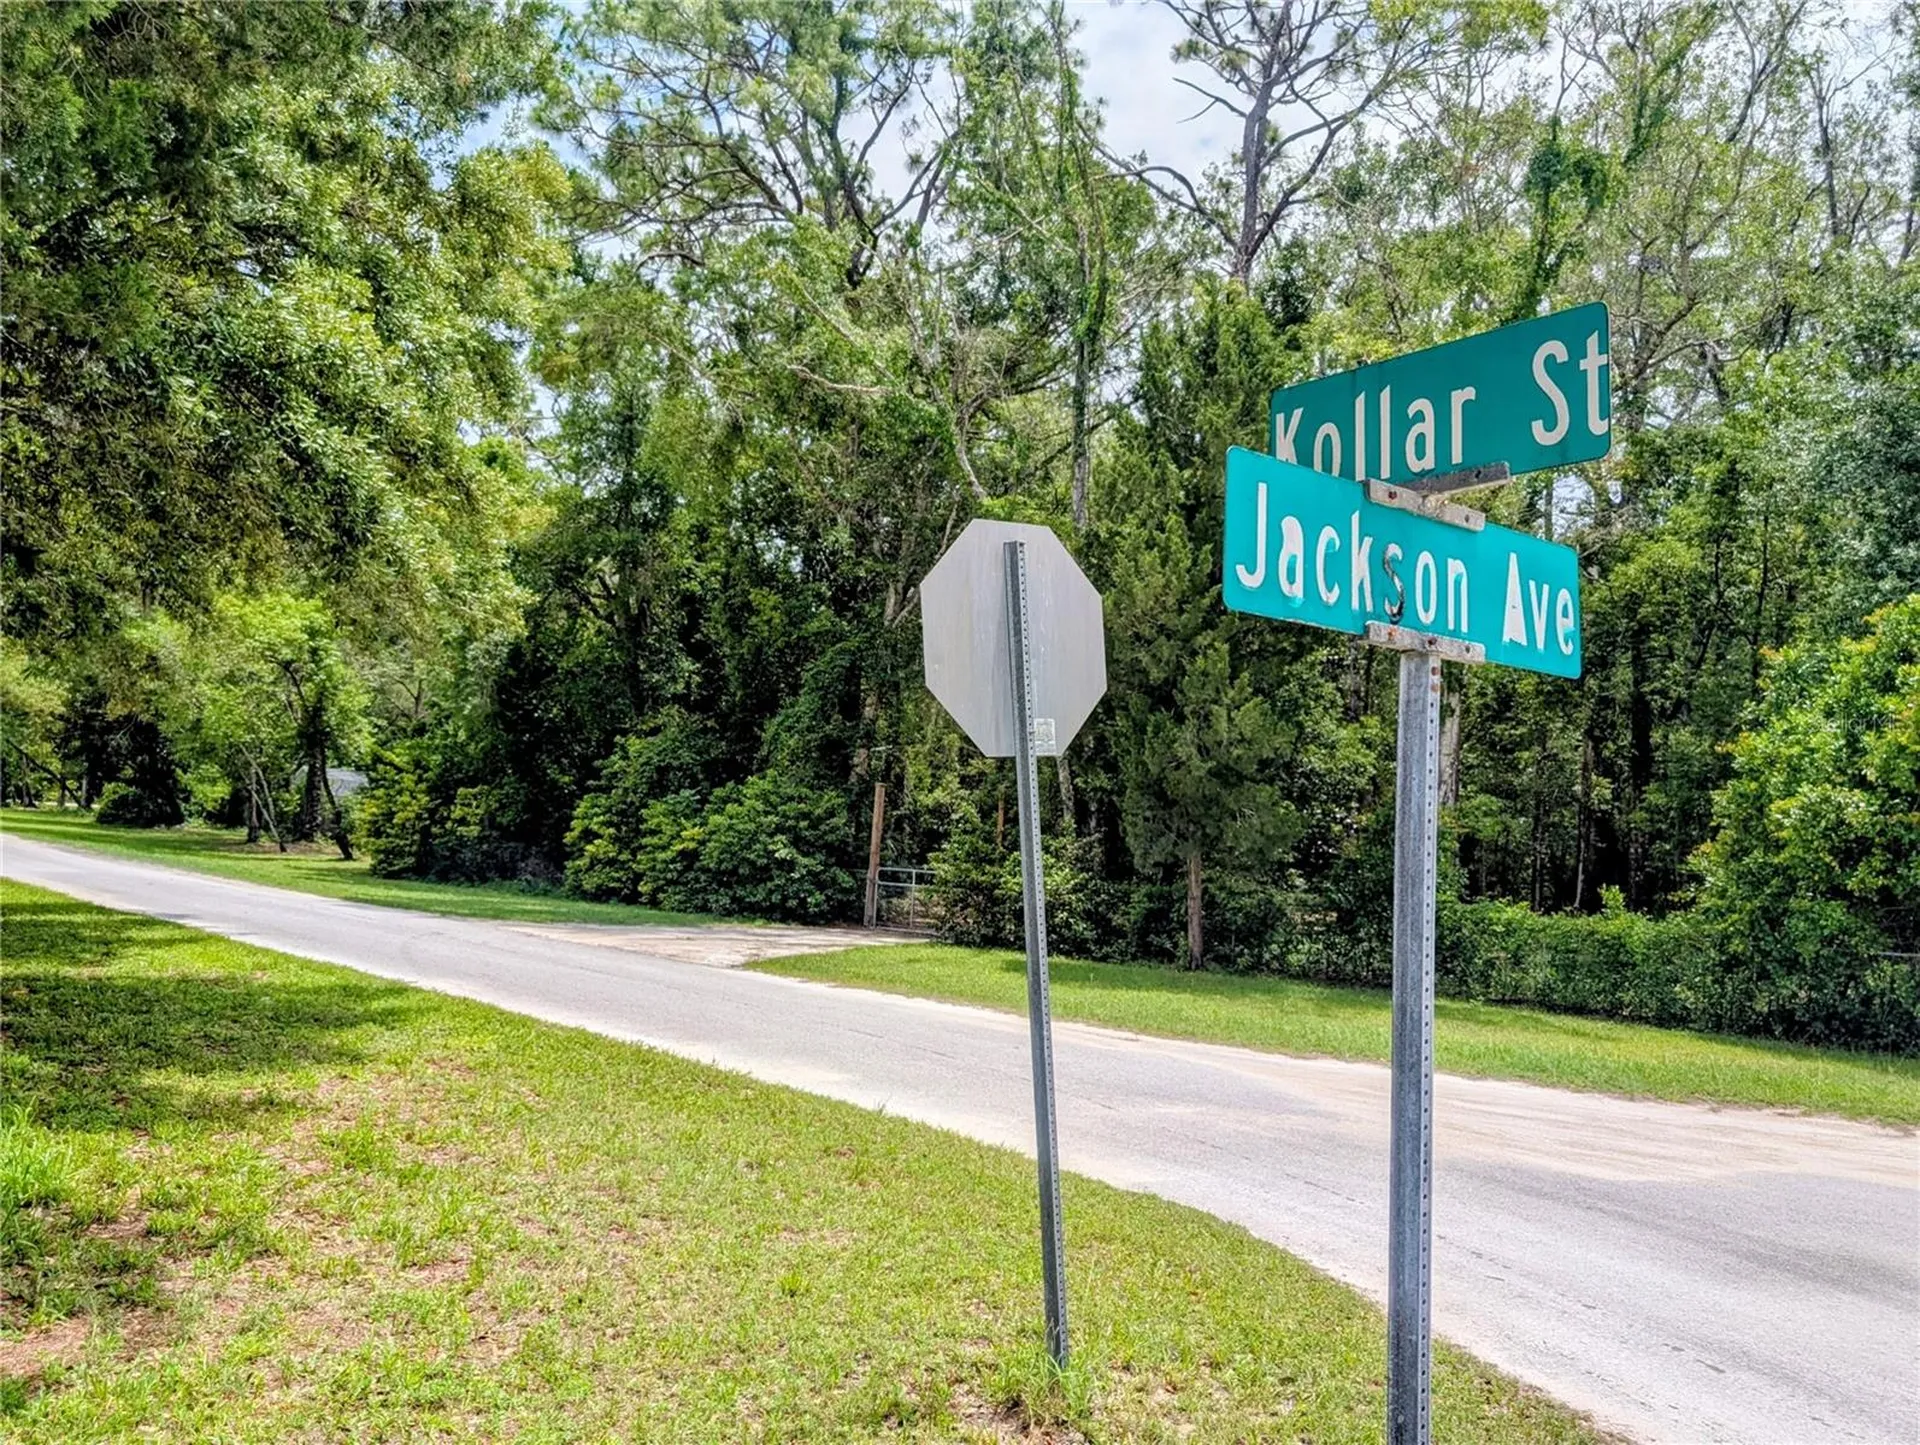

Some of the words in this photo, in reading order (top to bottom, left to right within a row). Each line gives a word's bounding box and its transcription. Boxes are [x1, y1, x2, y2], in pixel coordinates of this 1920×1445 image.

[1275, 385, 1476, 482] Kollar
[1531, 330, 1609, 446] St
[1236, 482, 1468, 633] Jackson
[1502, 552, 1574, 655] Ave
